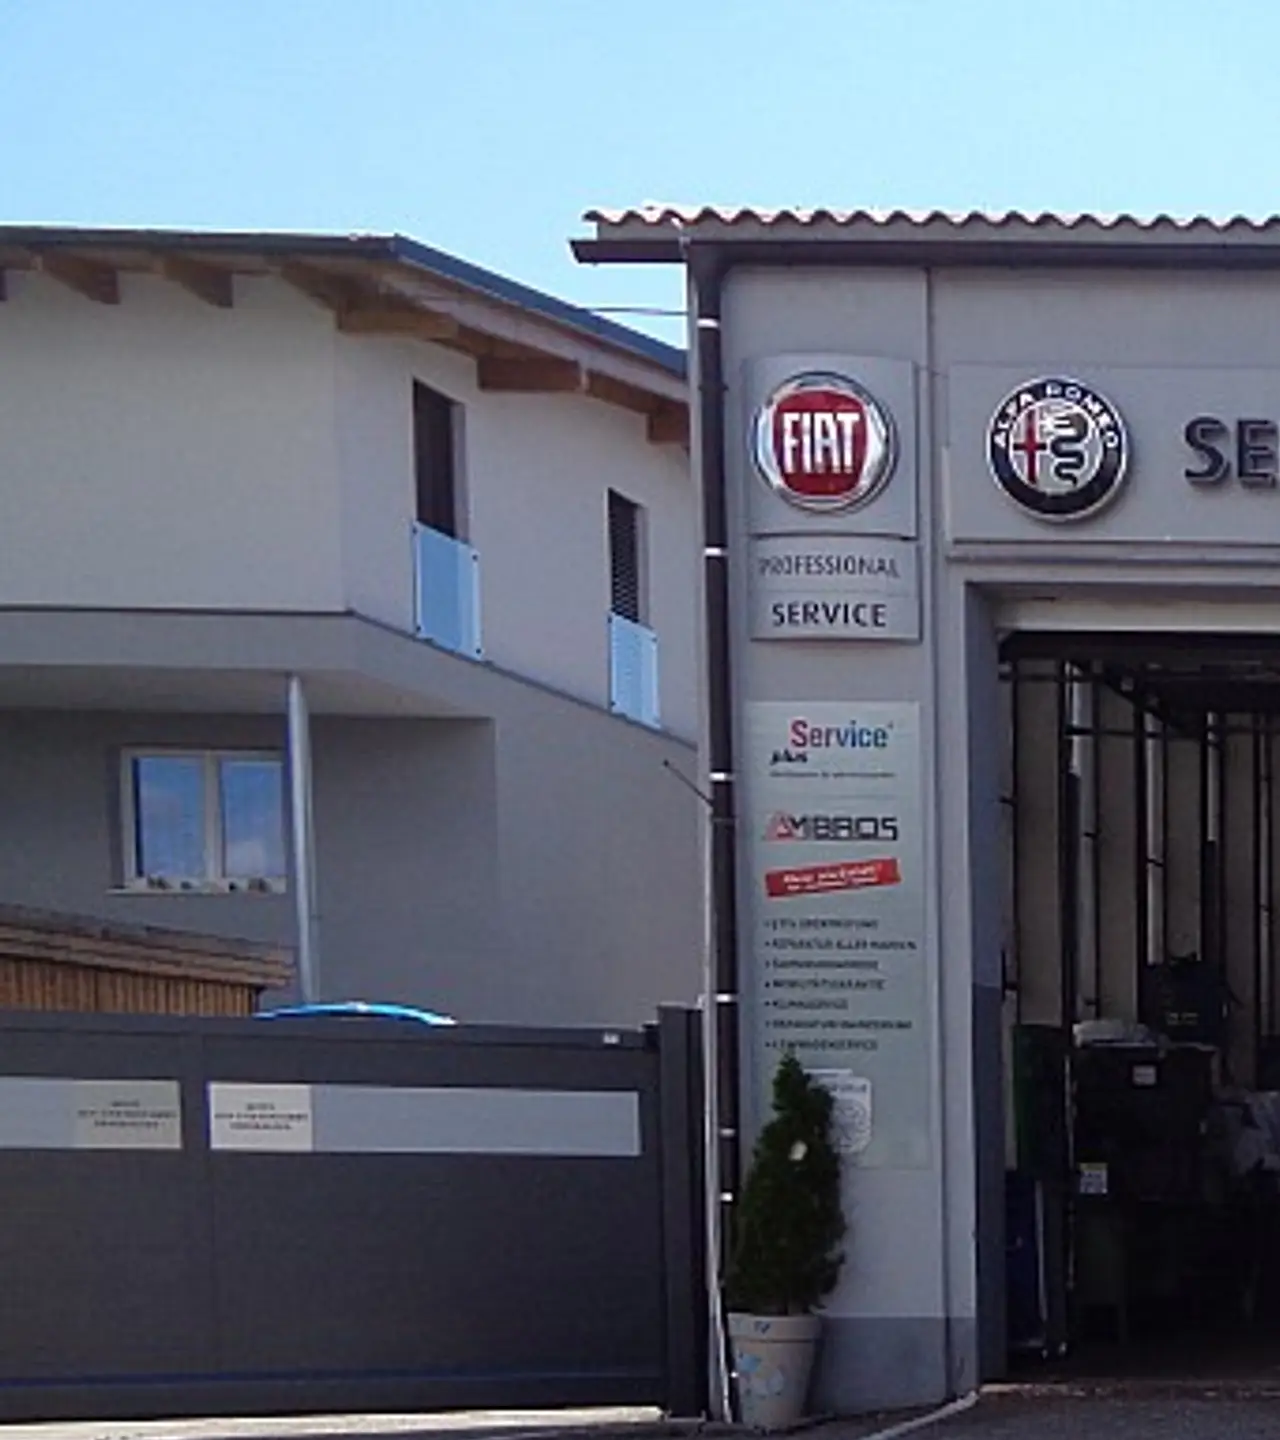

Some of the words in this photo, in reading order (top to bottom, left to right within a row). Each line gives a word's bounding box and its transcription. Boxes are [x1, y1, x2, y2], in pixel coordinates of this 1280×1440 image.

[993, 390, 1035, 449] ALFA
[1046, 382, 1118, 451] ROMEO
[781, 411, 861, 475] FIAT
[758, 554, 902, 579] PROFESSIONAL
[771, 602, 887, 628] SERVICE
[790, 718, 889, 749] Service
[763, 811, 898, 842] AMBROS
